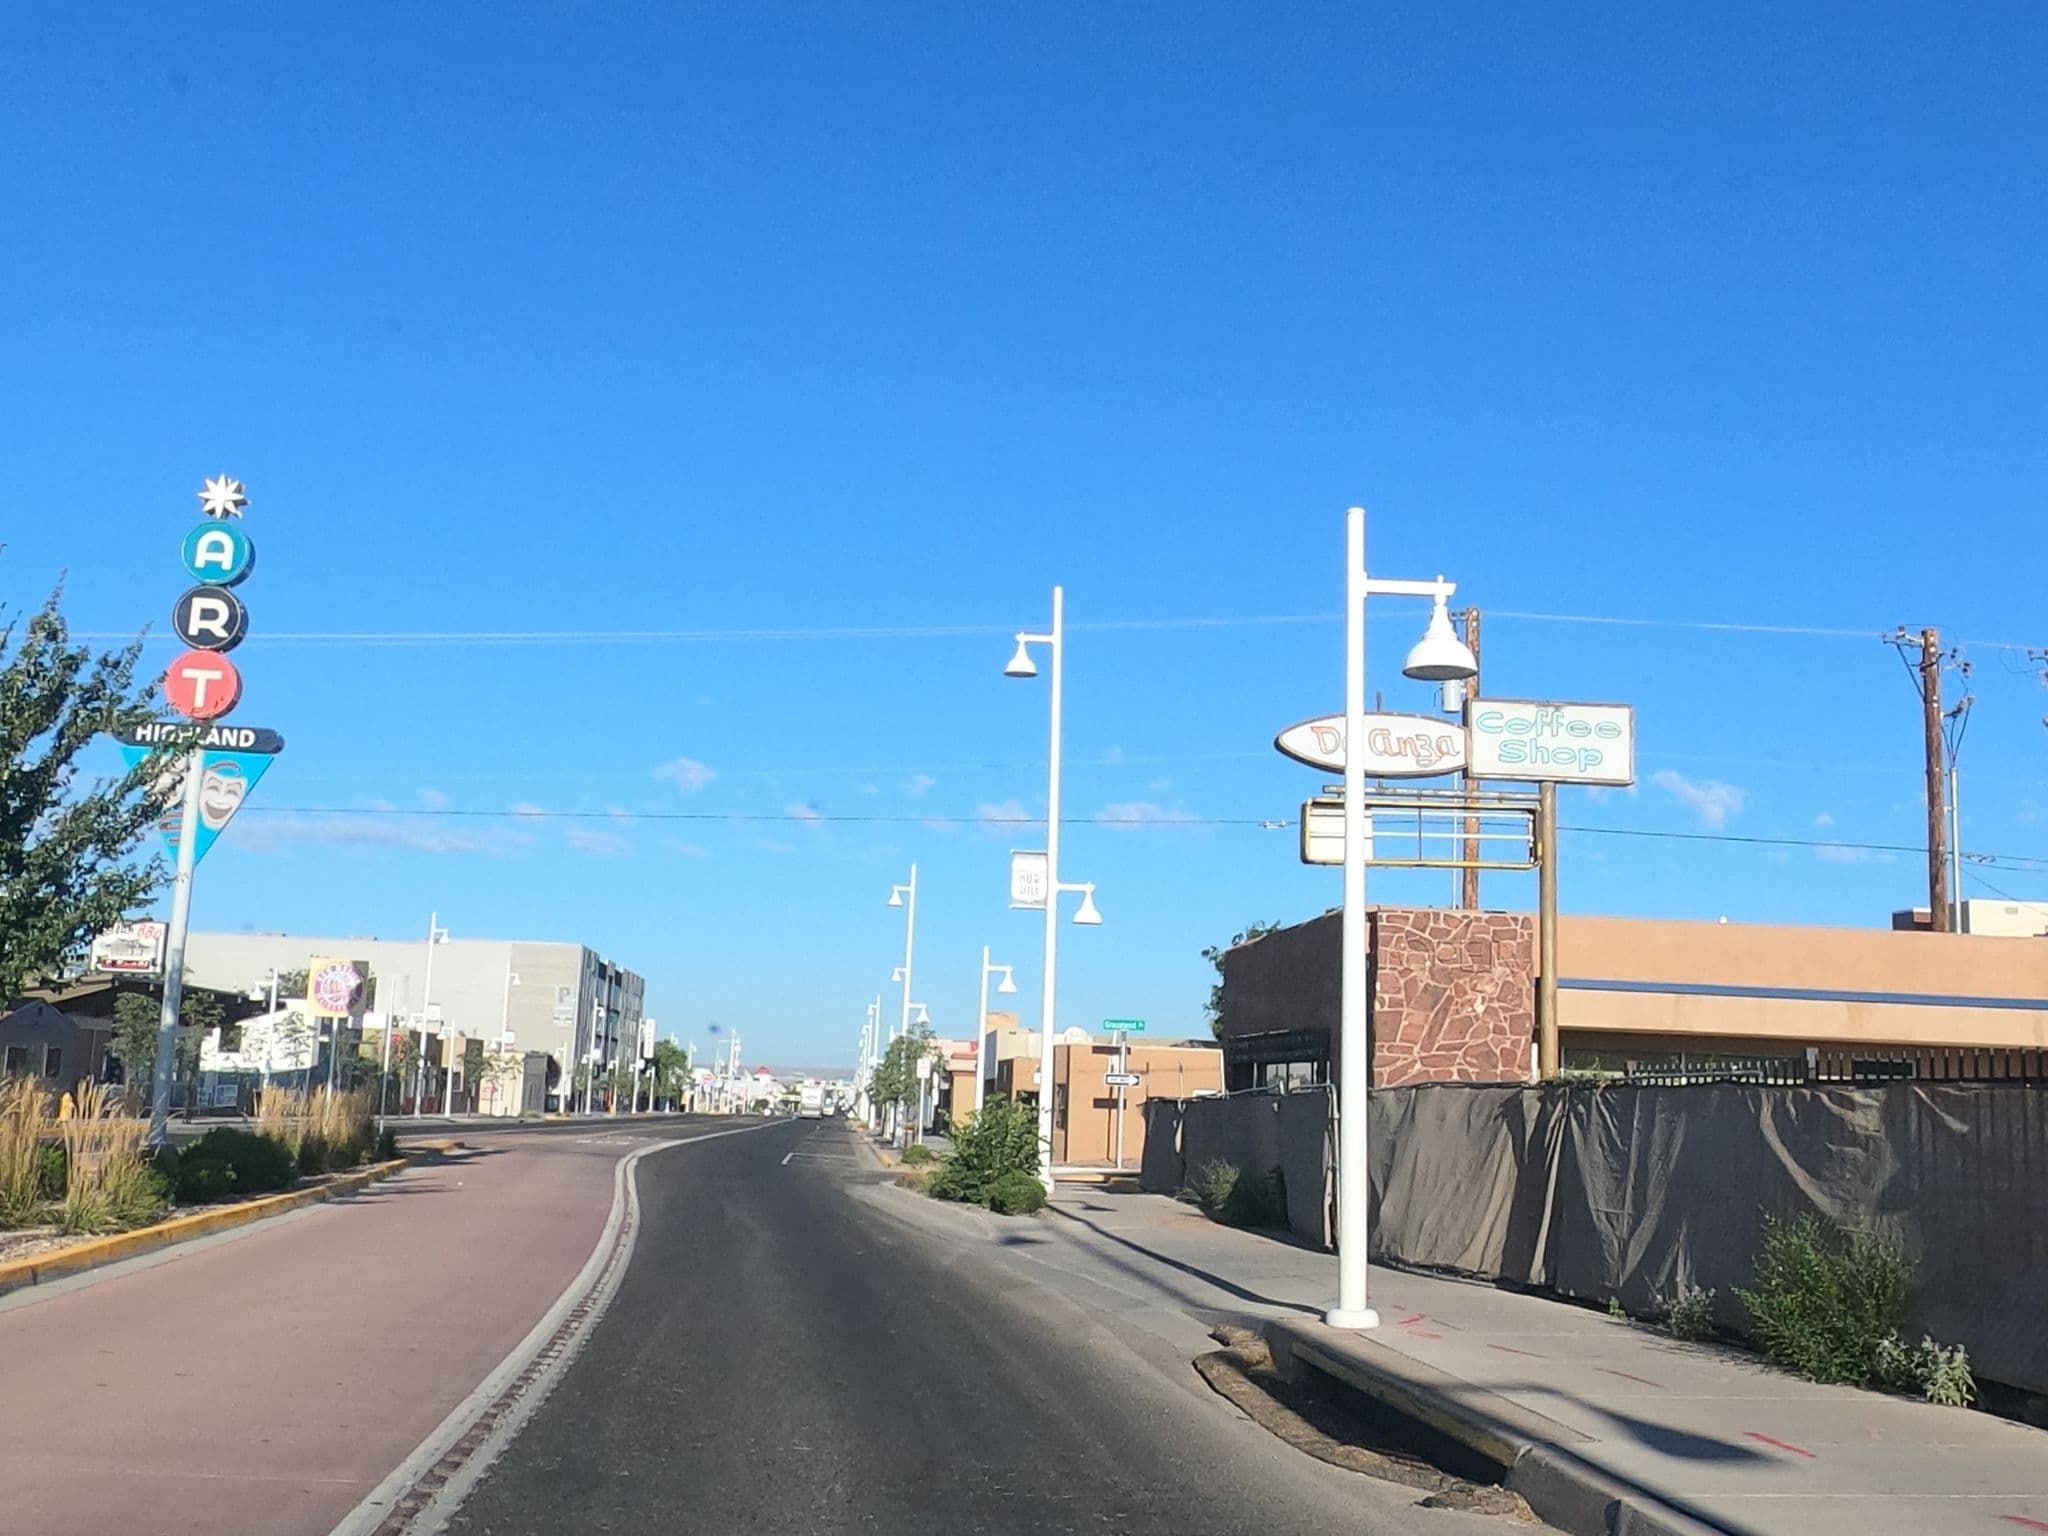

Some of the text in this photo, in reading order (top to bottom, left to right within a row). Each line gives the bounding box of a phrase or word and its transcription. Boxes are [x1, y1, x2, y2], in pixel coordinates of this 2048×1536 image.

[181, 530, 234, 708] ART
[1476, 709, 1622, 739] Coffee
[1498, 738, 1603, 773] Shop
